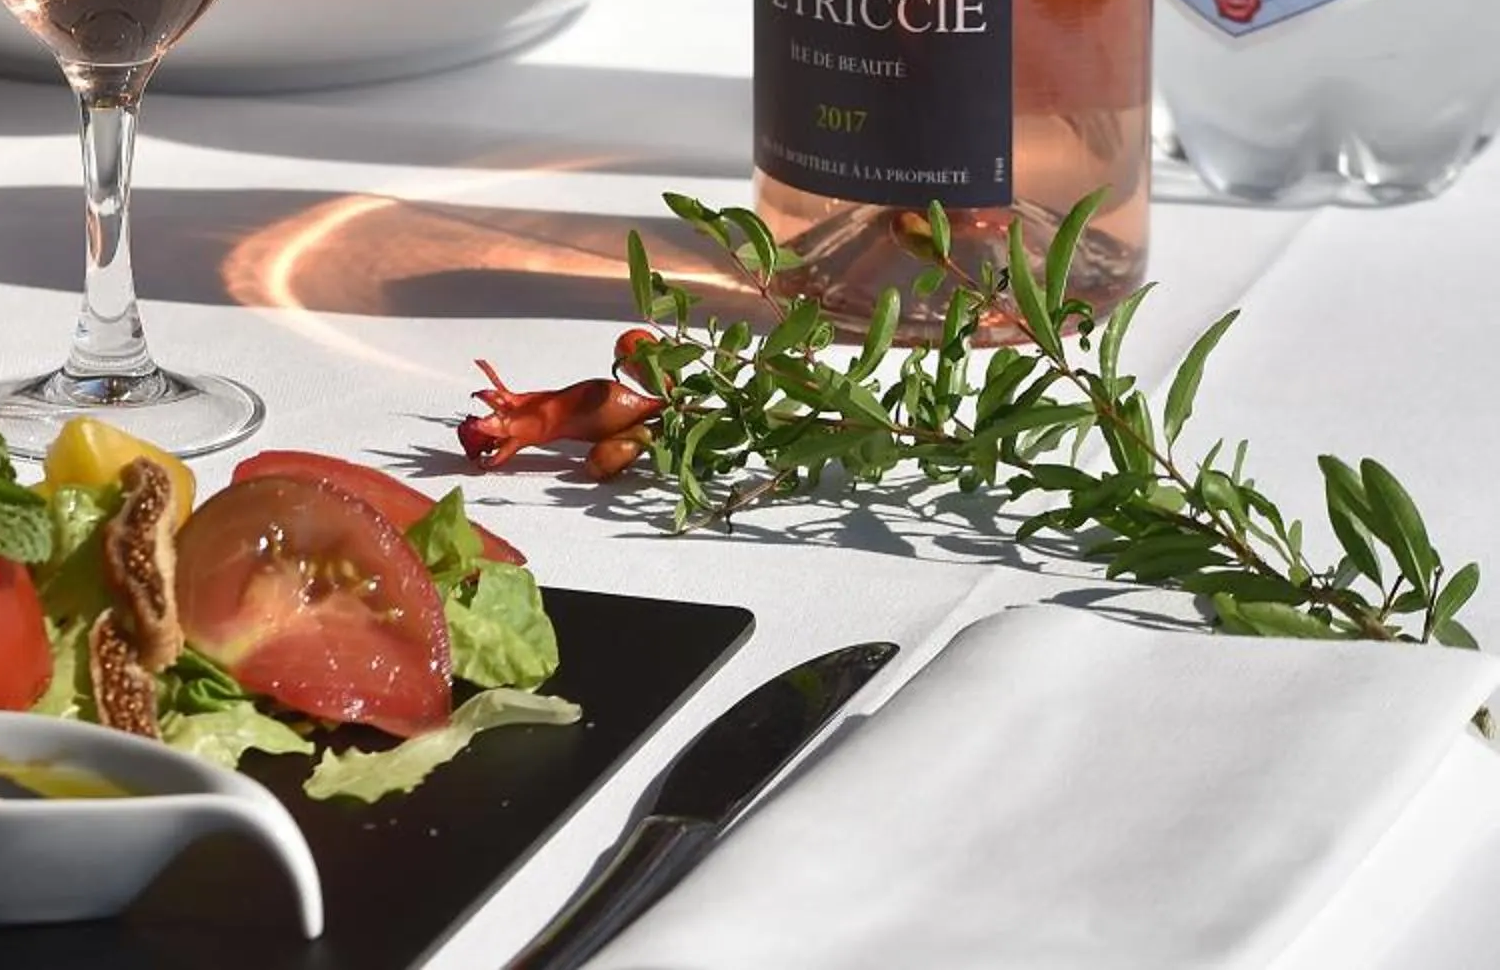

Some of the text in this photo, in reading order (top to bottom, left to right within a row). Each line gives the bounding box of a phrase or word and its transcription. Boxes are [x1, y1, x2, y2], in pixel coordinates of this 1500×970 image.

[813, 49, 835, 69] DE
[838, 53, 908, 78] BEAUTÉ
[816, 103, 869, 134] 2017
[865, 166, 883, 181] LA
[887, 167, 970, 185] PROPRIÉTÉ
